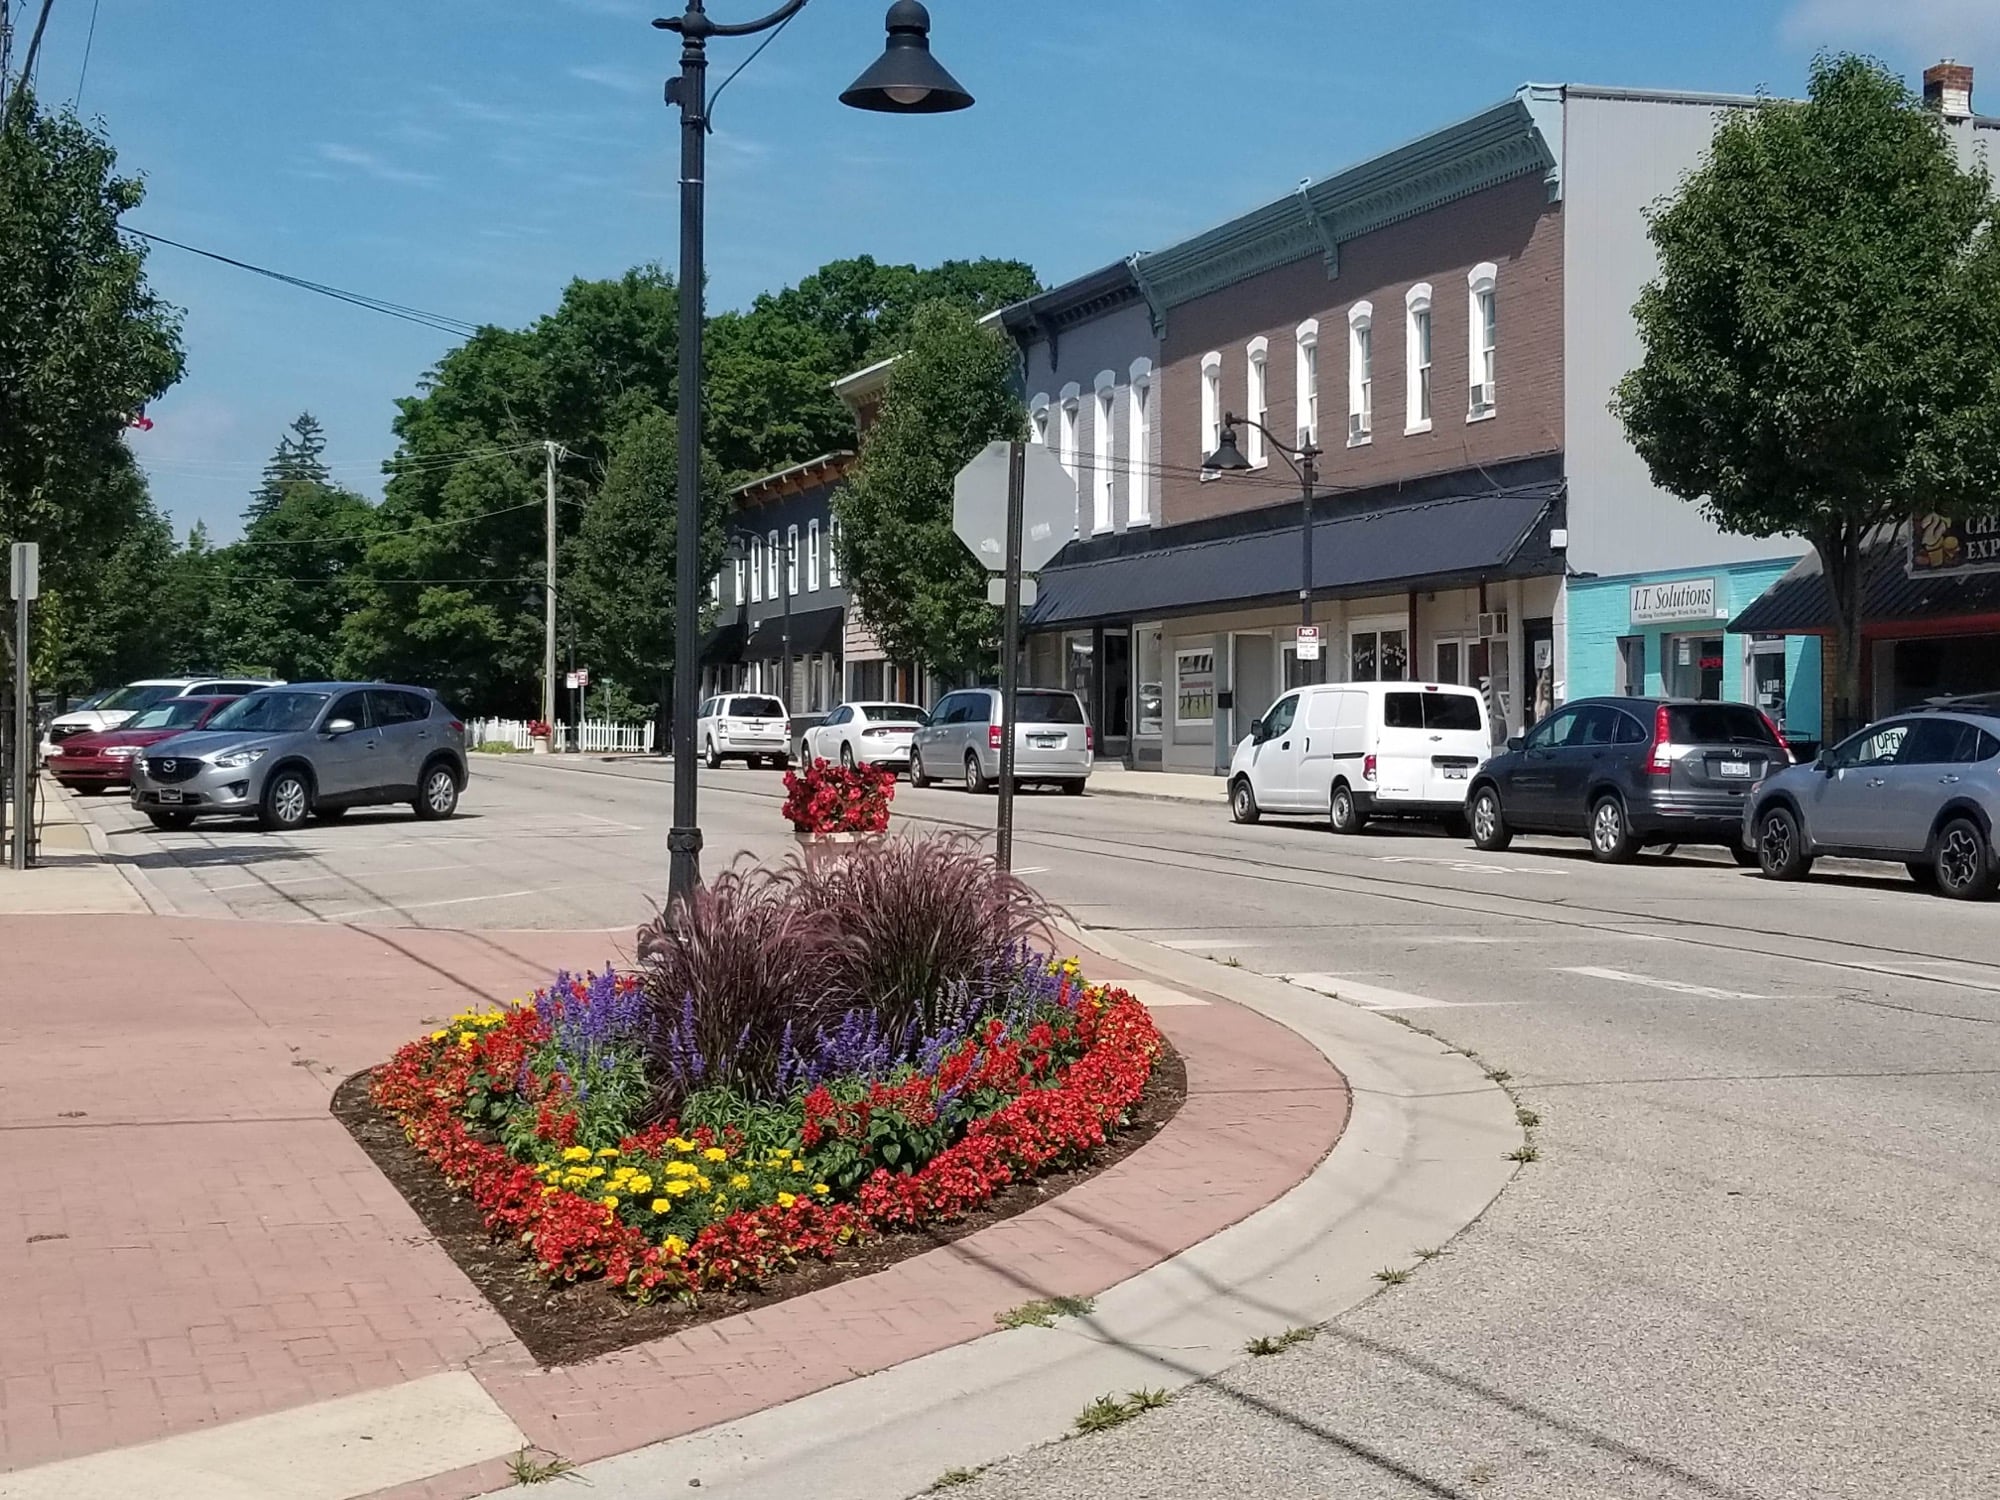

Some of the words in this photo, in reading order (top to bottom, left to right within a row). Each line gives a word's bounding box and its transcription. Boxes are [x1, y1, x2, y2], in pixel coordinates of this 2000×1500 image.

[1966, 538, 2000, 560] EXP
[1634, 589, 1651, 611] I.T.
[1655, 585, 1712, 609] Solutions
[1876, 732, 1904, 749] OPEN
